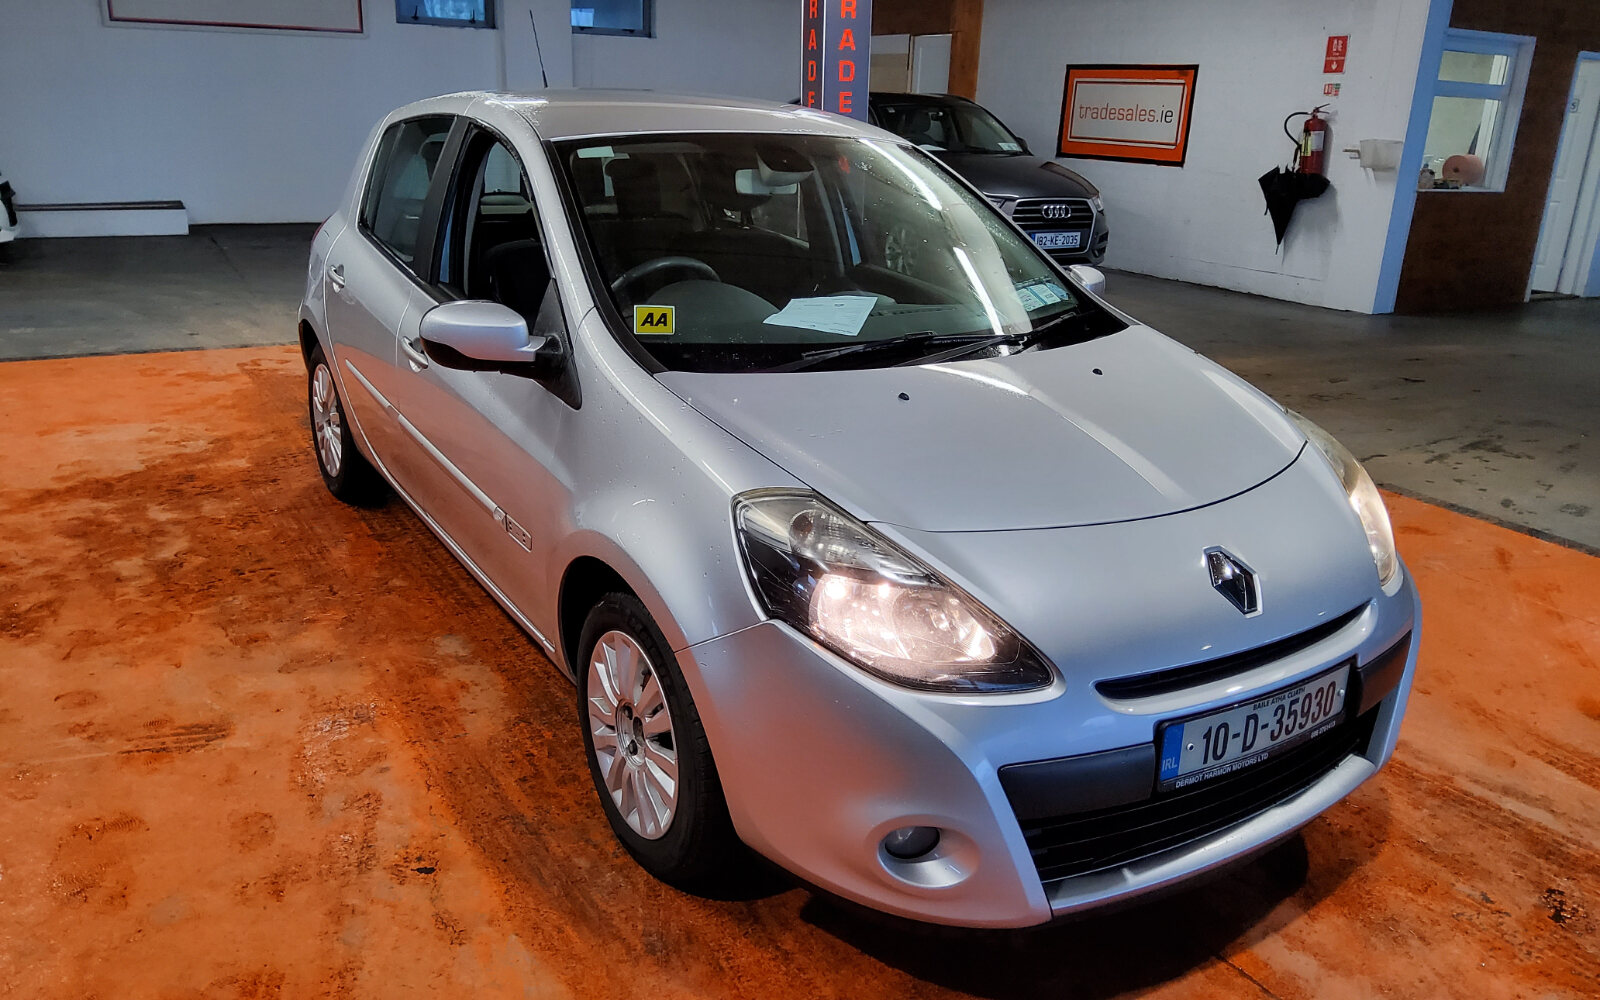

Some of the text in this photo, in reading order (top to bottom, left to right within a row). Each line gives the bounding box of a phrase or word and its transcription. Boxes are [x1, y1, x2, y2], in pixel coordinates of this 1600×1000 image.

[1079, 102, 1174, 124] tradesales.ie
[1036, 234, 1079, 246] 182-KE-2035
[640, 312, 668, 327] AA
[1202, 680, 1337, 765] 10-D-35930
[1161, 757, 1179, 773] IRL
[1175, 752, 1269, 788] DERMOT HARMON MOTORS LTD
